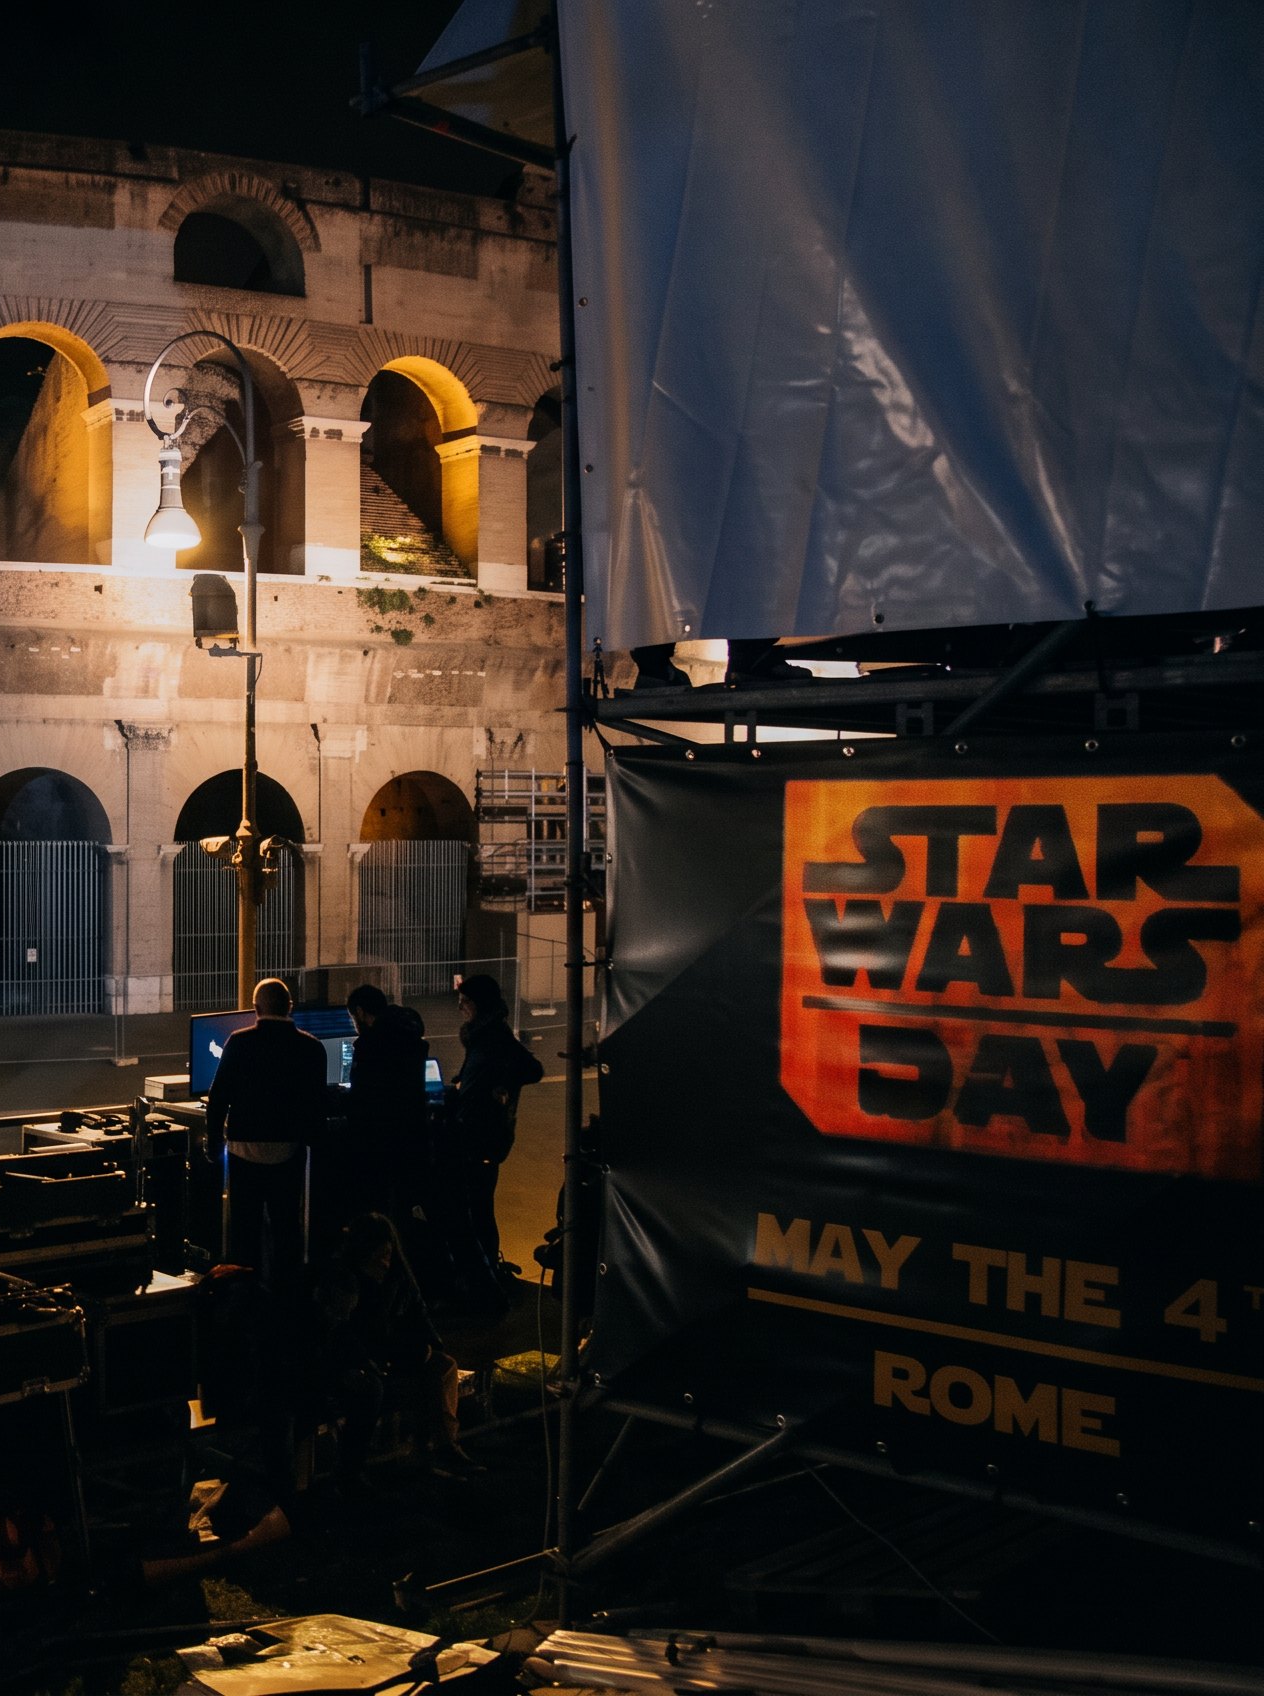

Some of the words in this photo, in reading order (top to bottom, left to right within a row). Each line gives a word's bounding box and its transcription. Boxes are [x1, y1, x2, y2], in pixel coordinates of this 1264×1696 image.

[802, 803, 1241, 901] STAR
[803, 899, 1241, 1004] WARS
[858, 1025, 1159, 1143] DAY
[753, 1211, 923, 1290] MAY
[951, 1242, 1122, 1330] THE
[872, 1349, 1122, 1458] ROME
